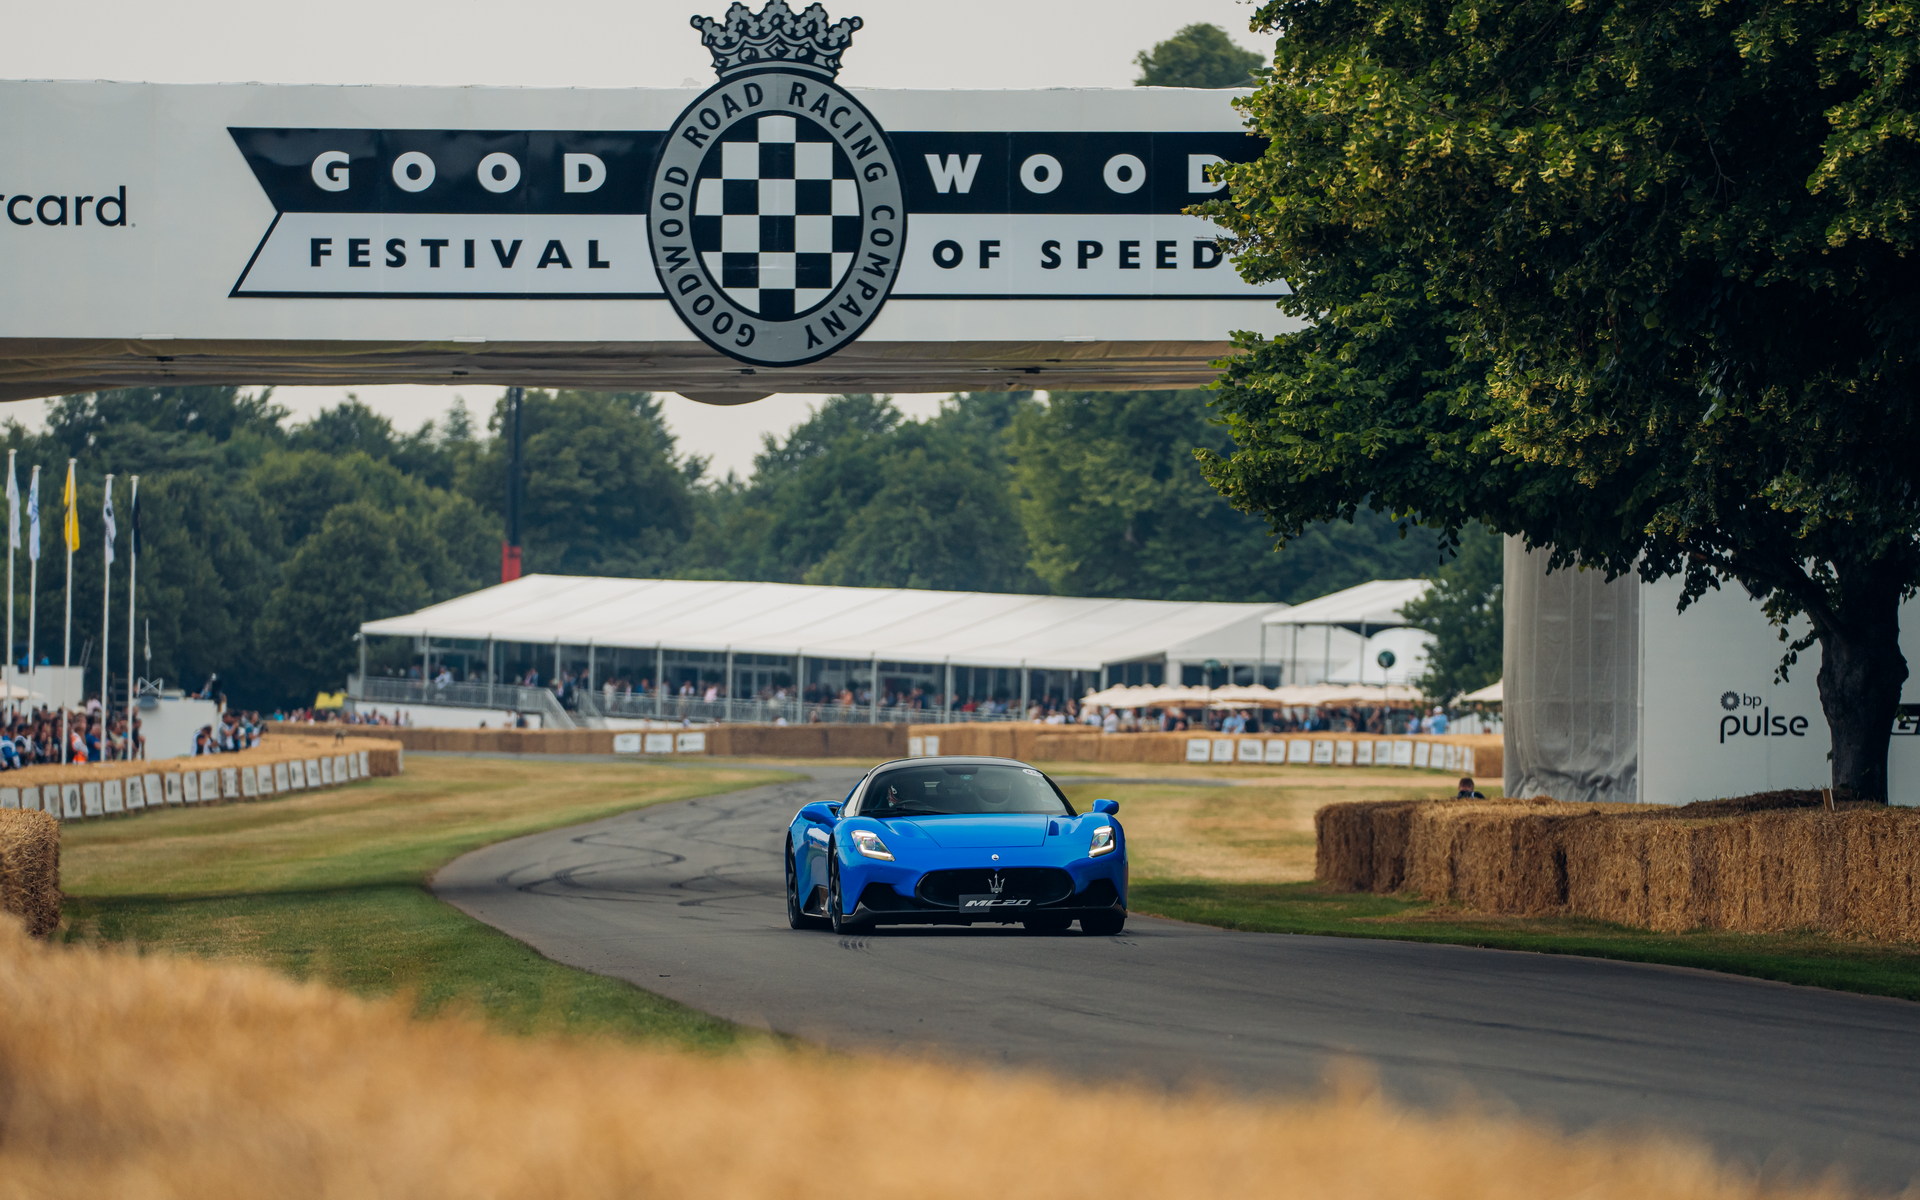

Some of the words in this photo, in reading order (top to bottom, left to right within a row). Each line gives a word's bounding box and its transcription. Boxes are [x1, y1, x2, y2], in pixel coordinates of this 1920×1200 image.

[682, 82, 764, 149] ROAD
[788, 81, 888, 183] RACING
[310, 150, 607, 194] GOOD
[924, 153, 1228, 194] WOOD
[0, 185, 127, 227] card
[310, 237, 610, 269] FESTIVAL
[932, 239, 1001, 270] OF
[1040, 239, 1224, 270] SPEED
[659, 166, 756, 347] GOODWOOD
[804, 204, 896, 350] COMPANY
[1743, 692, 1762, 710] bp
[1720, 706, 1809, 744] pulse
[965, 899, 1032, 907] MC20
